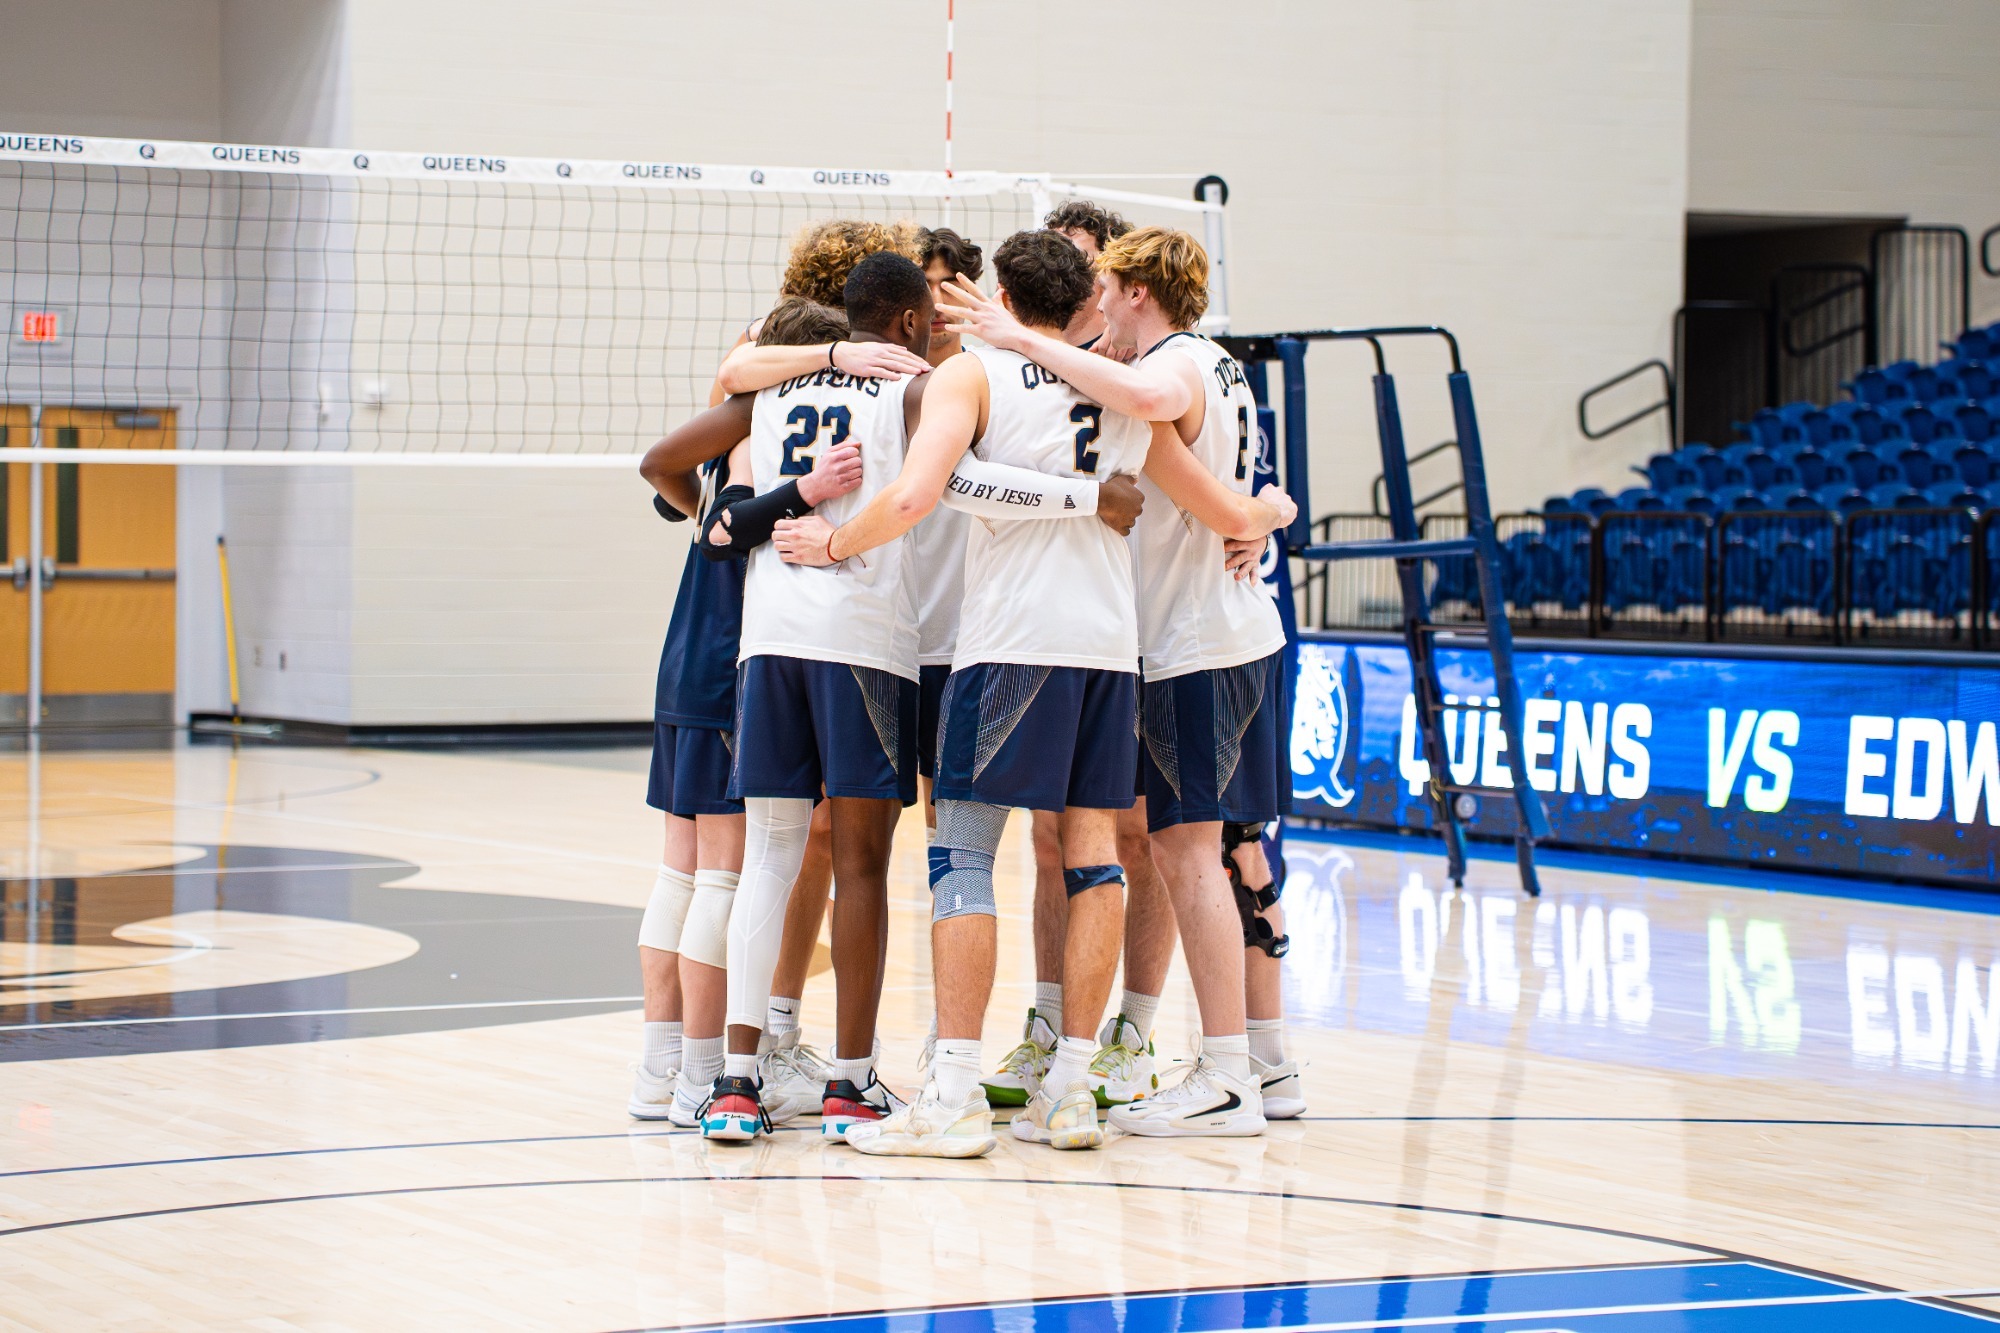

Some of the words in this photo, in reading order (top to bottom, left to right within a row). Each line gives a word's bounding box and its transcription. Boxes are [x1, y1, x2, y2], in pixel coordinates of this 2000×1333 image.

[211, 146, 300, 164] QUEENS
[422, 156, 506, 173] QUEENS
[622, 164, 702, 180] QUEENS
[812, 171, 890, 186] QUEENS
[1068, 401, 1105, 475] 2
[948, 471, 973, 495] ED
[972, 483, 998, 500] BY
[996, 488, 1043, 507] JESUS
[1399, 693, 1653, 800] QUEENS
[1707, 707, 1800, 813] VS
[1844, 715, 2000, 827] EDW
